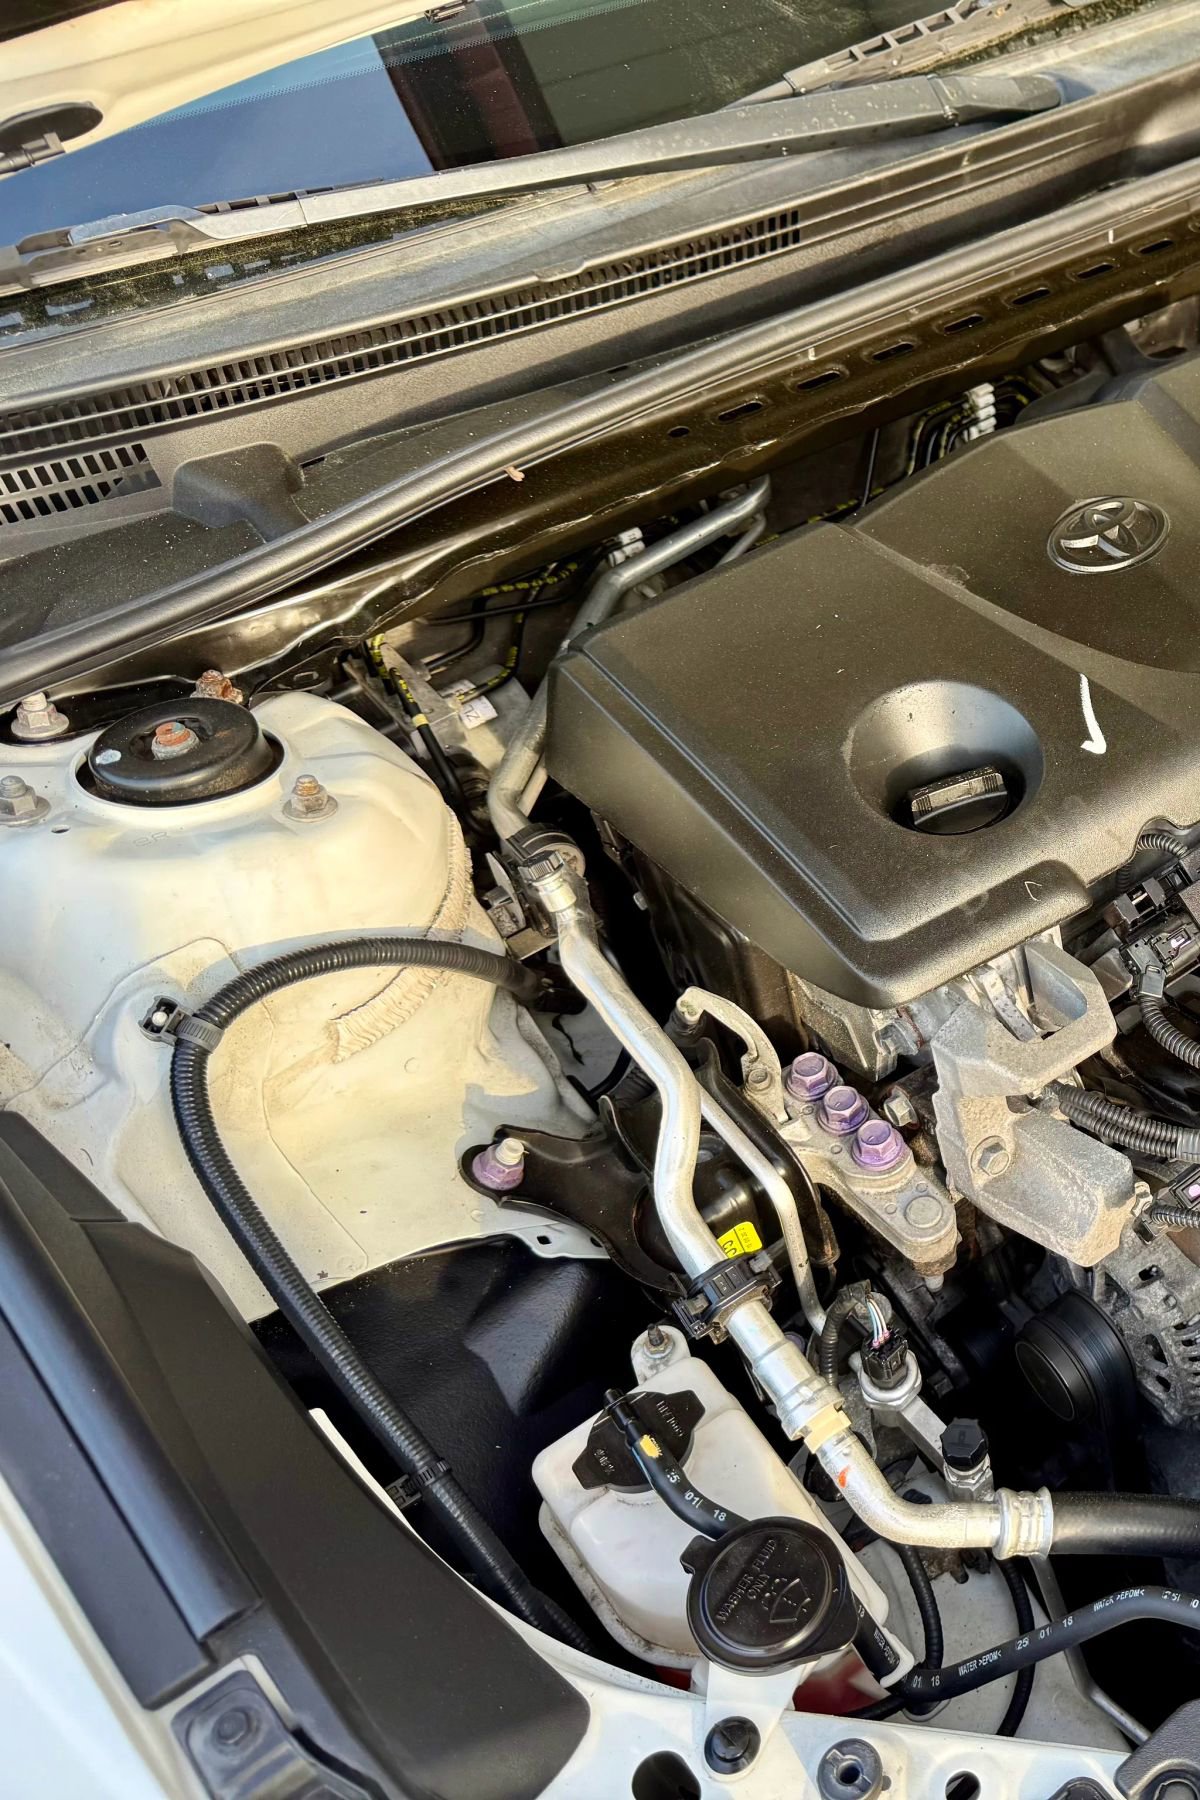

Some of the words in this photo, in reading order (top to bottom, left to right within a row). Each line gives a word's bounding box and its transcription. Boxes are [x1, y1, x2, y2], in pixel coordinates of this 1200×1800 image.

[713, 1509, 728, 1523] 18
[715, 1573, 755, 1622] WASHER
[752, 1539, 778, 1573] FLUID
[930, 1675, 941, 1687] 18
[958, 1660, 978, 1677] WATER
[1062, 1615, 1074, 1627] 18
